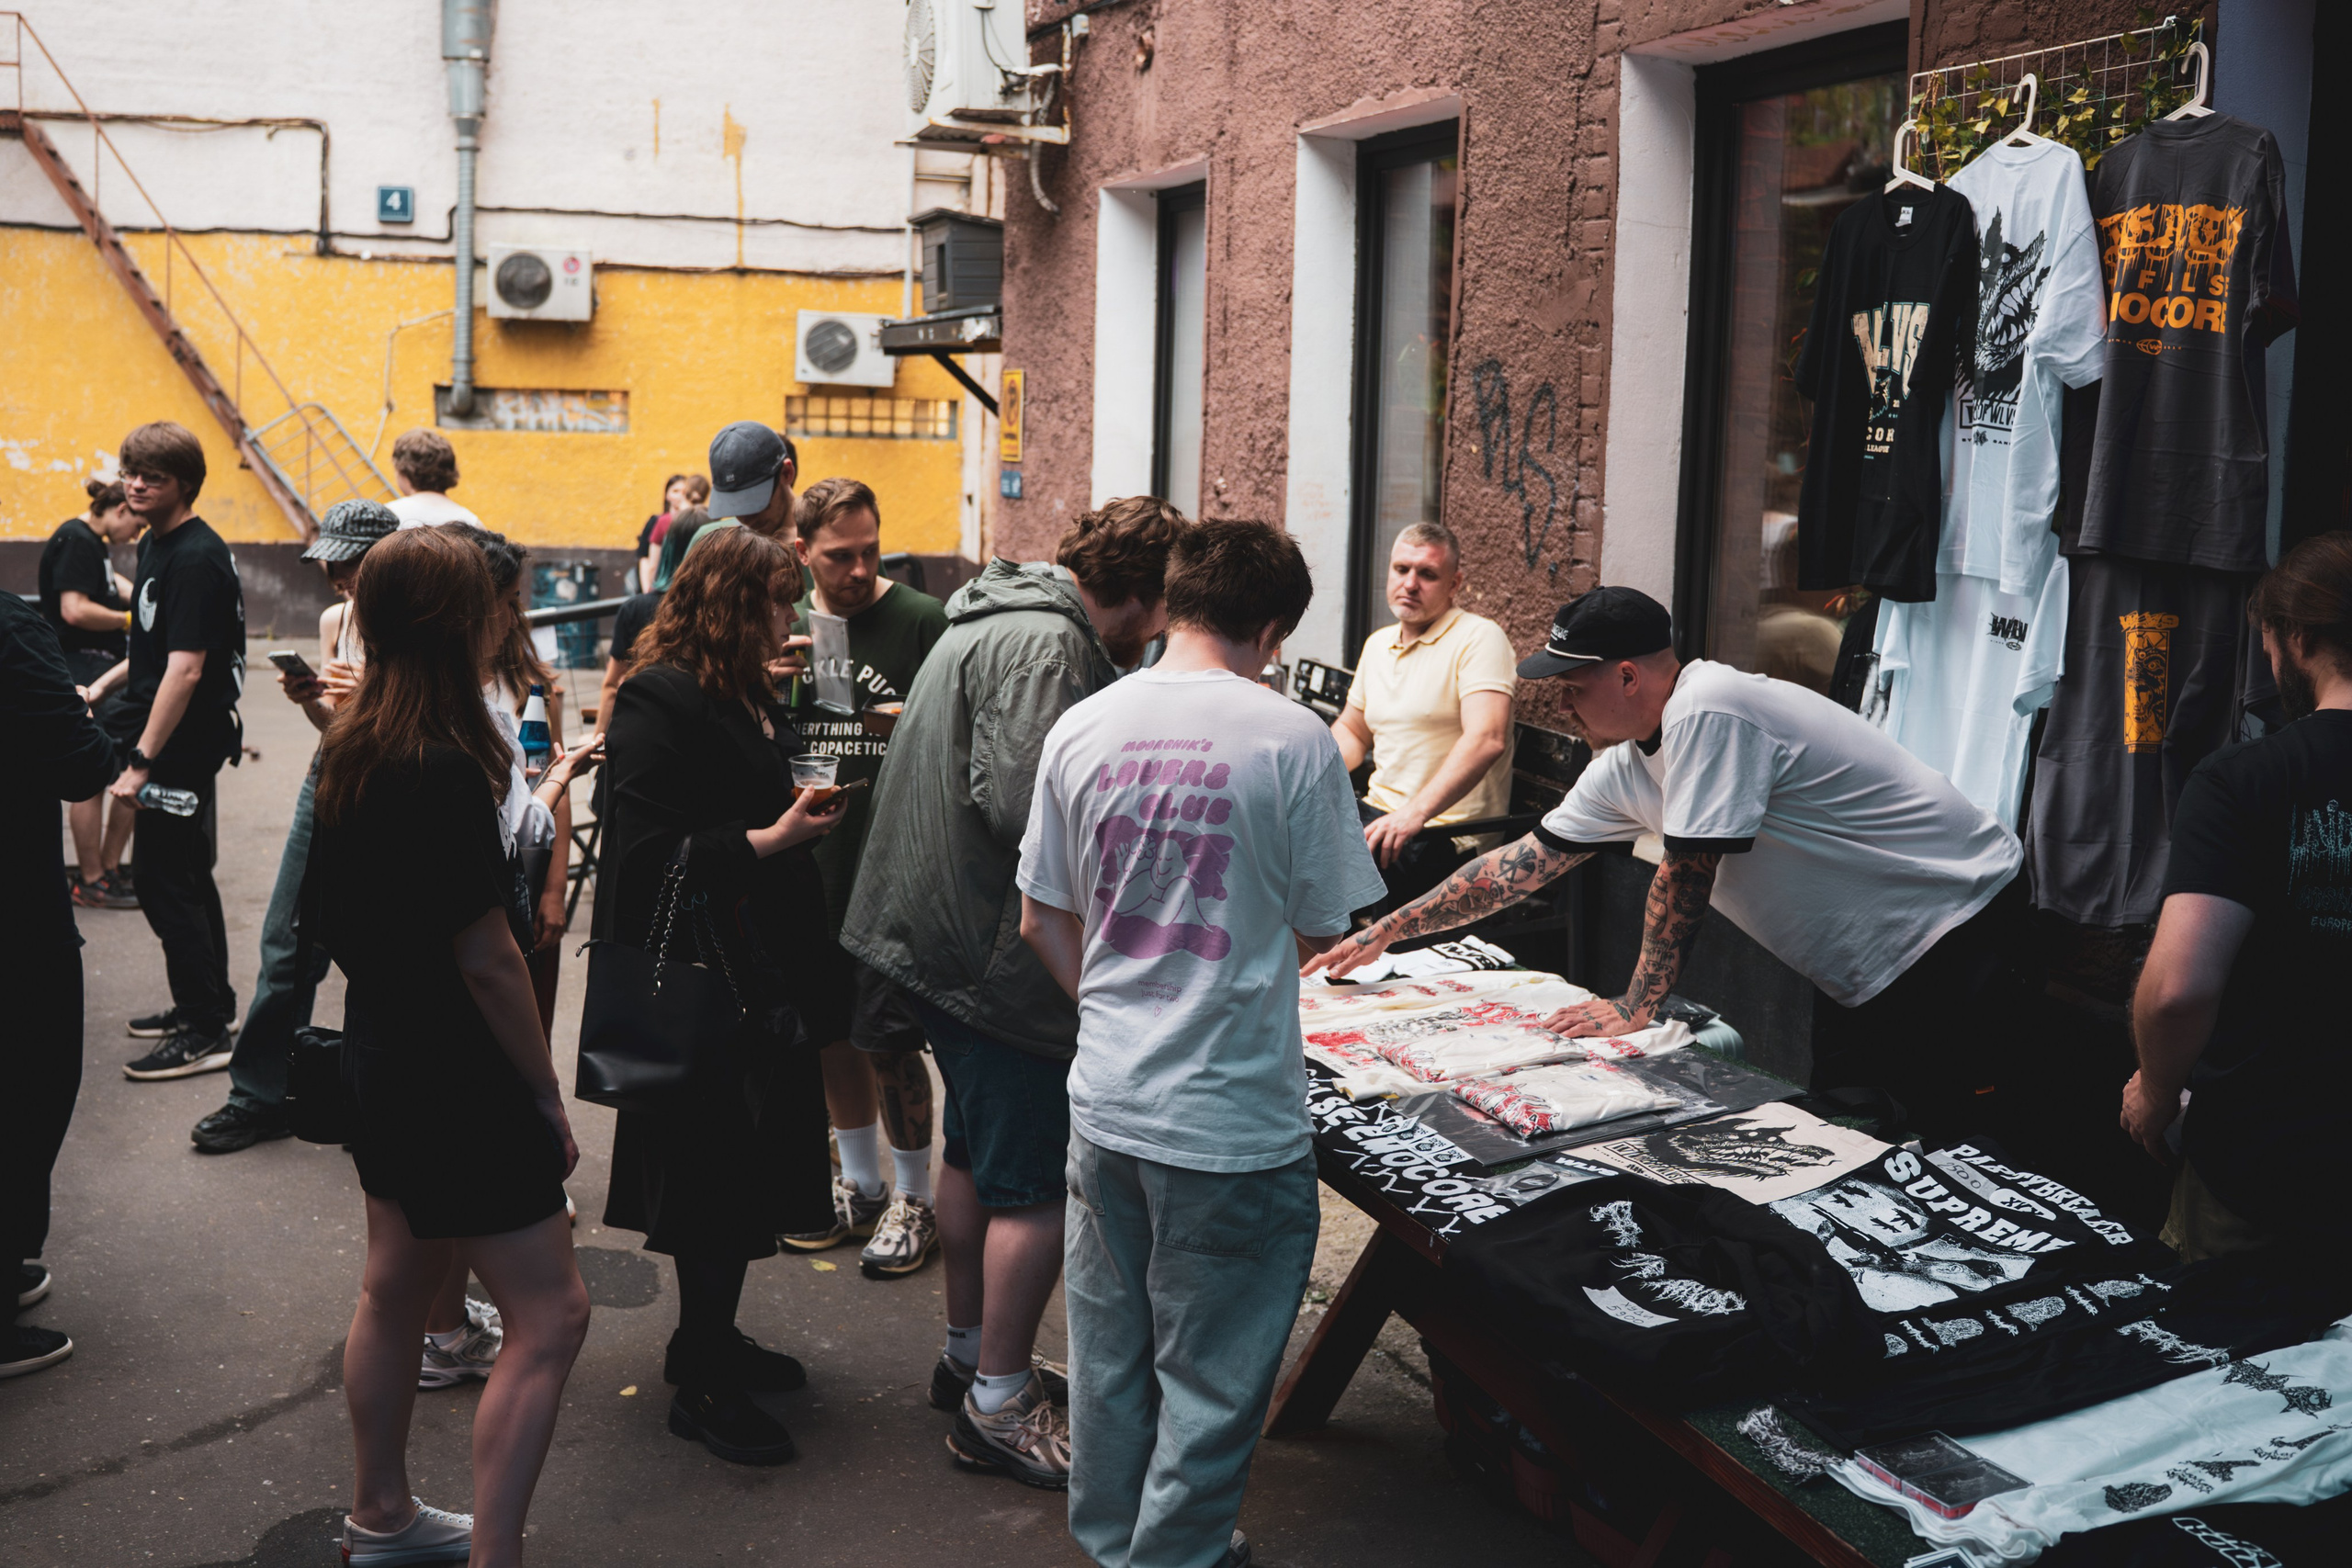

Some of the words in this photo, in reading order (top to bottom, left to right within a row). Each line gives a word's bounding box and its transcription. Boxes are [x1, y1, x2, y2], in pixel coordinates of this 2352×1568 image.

[386, 191, 401, 210] 4
[809, 740, 888, 756] COPACETIC
[1096, 758, 1231, 793] LOVERS
[1138, 792, 1233, 825] CLUB
[1138, 980, 1182, 994] membership
[1141, 988, 1155, 998] just
[1156, 990, 1166, 999] for
[1555, 1156, 1620, 1177] WLVS
[1937, 1162, 1982, 1189] 2500
[1606, 1304, 1645, 1325] 5900
